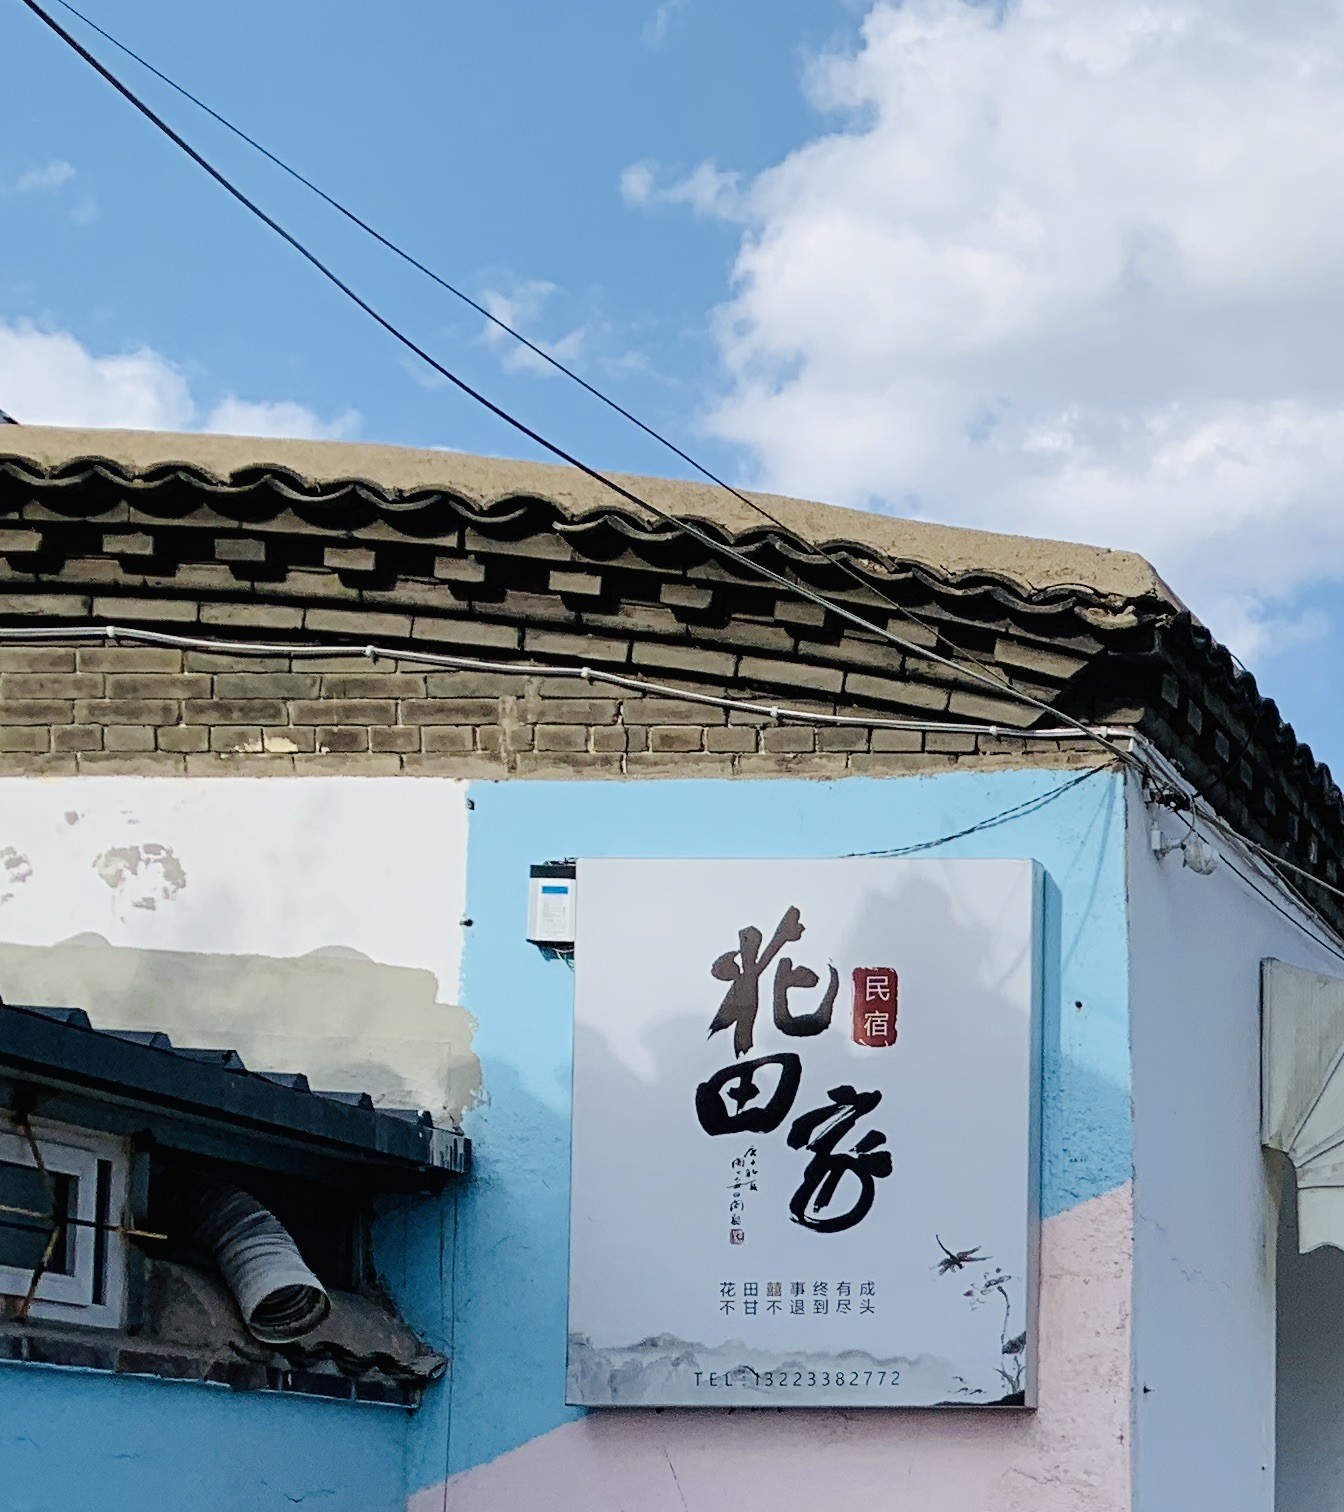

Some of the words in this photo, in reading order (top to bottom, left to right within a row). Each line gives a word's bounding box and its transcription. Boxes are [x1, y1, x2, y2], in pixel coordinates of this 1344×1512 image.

[863, 976, 890, 1037] 民宿
[719, 1280, 876, 1298] 花田囍事终有成
[719, 1299, 876, 1316] 不甘不退到尽头
